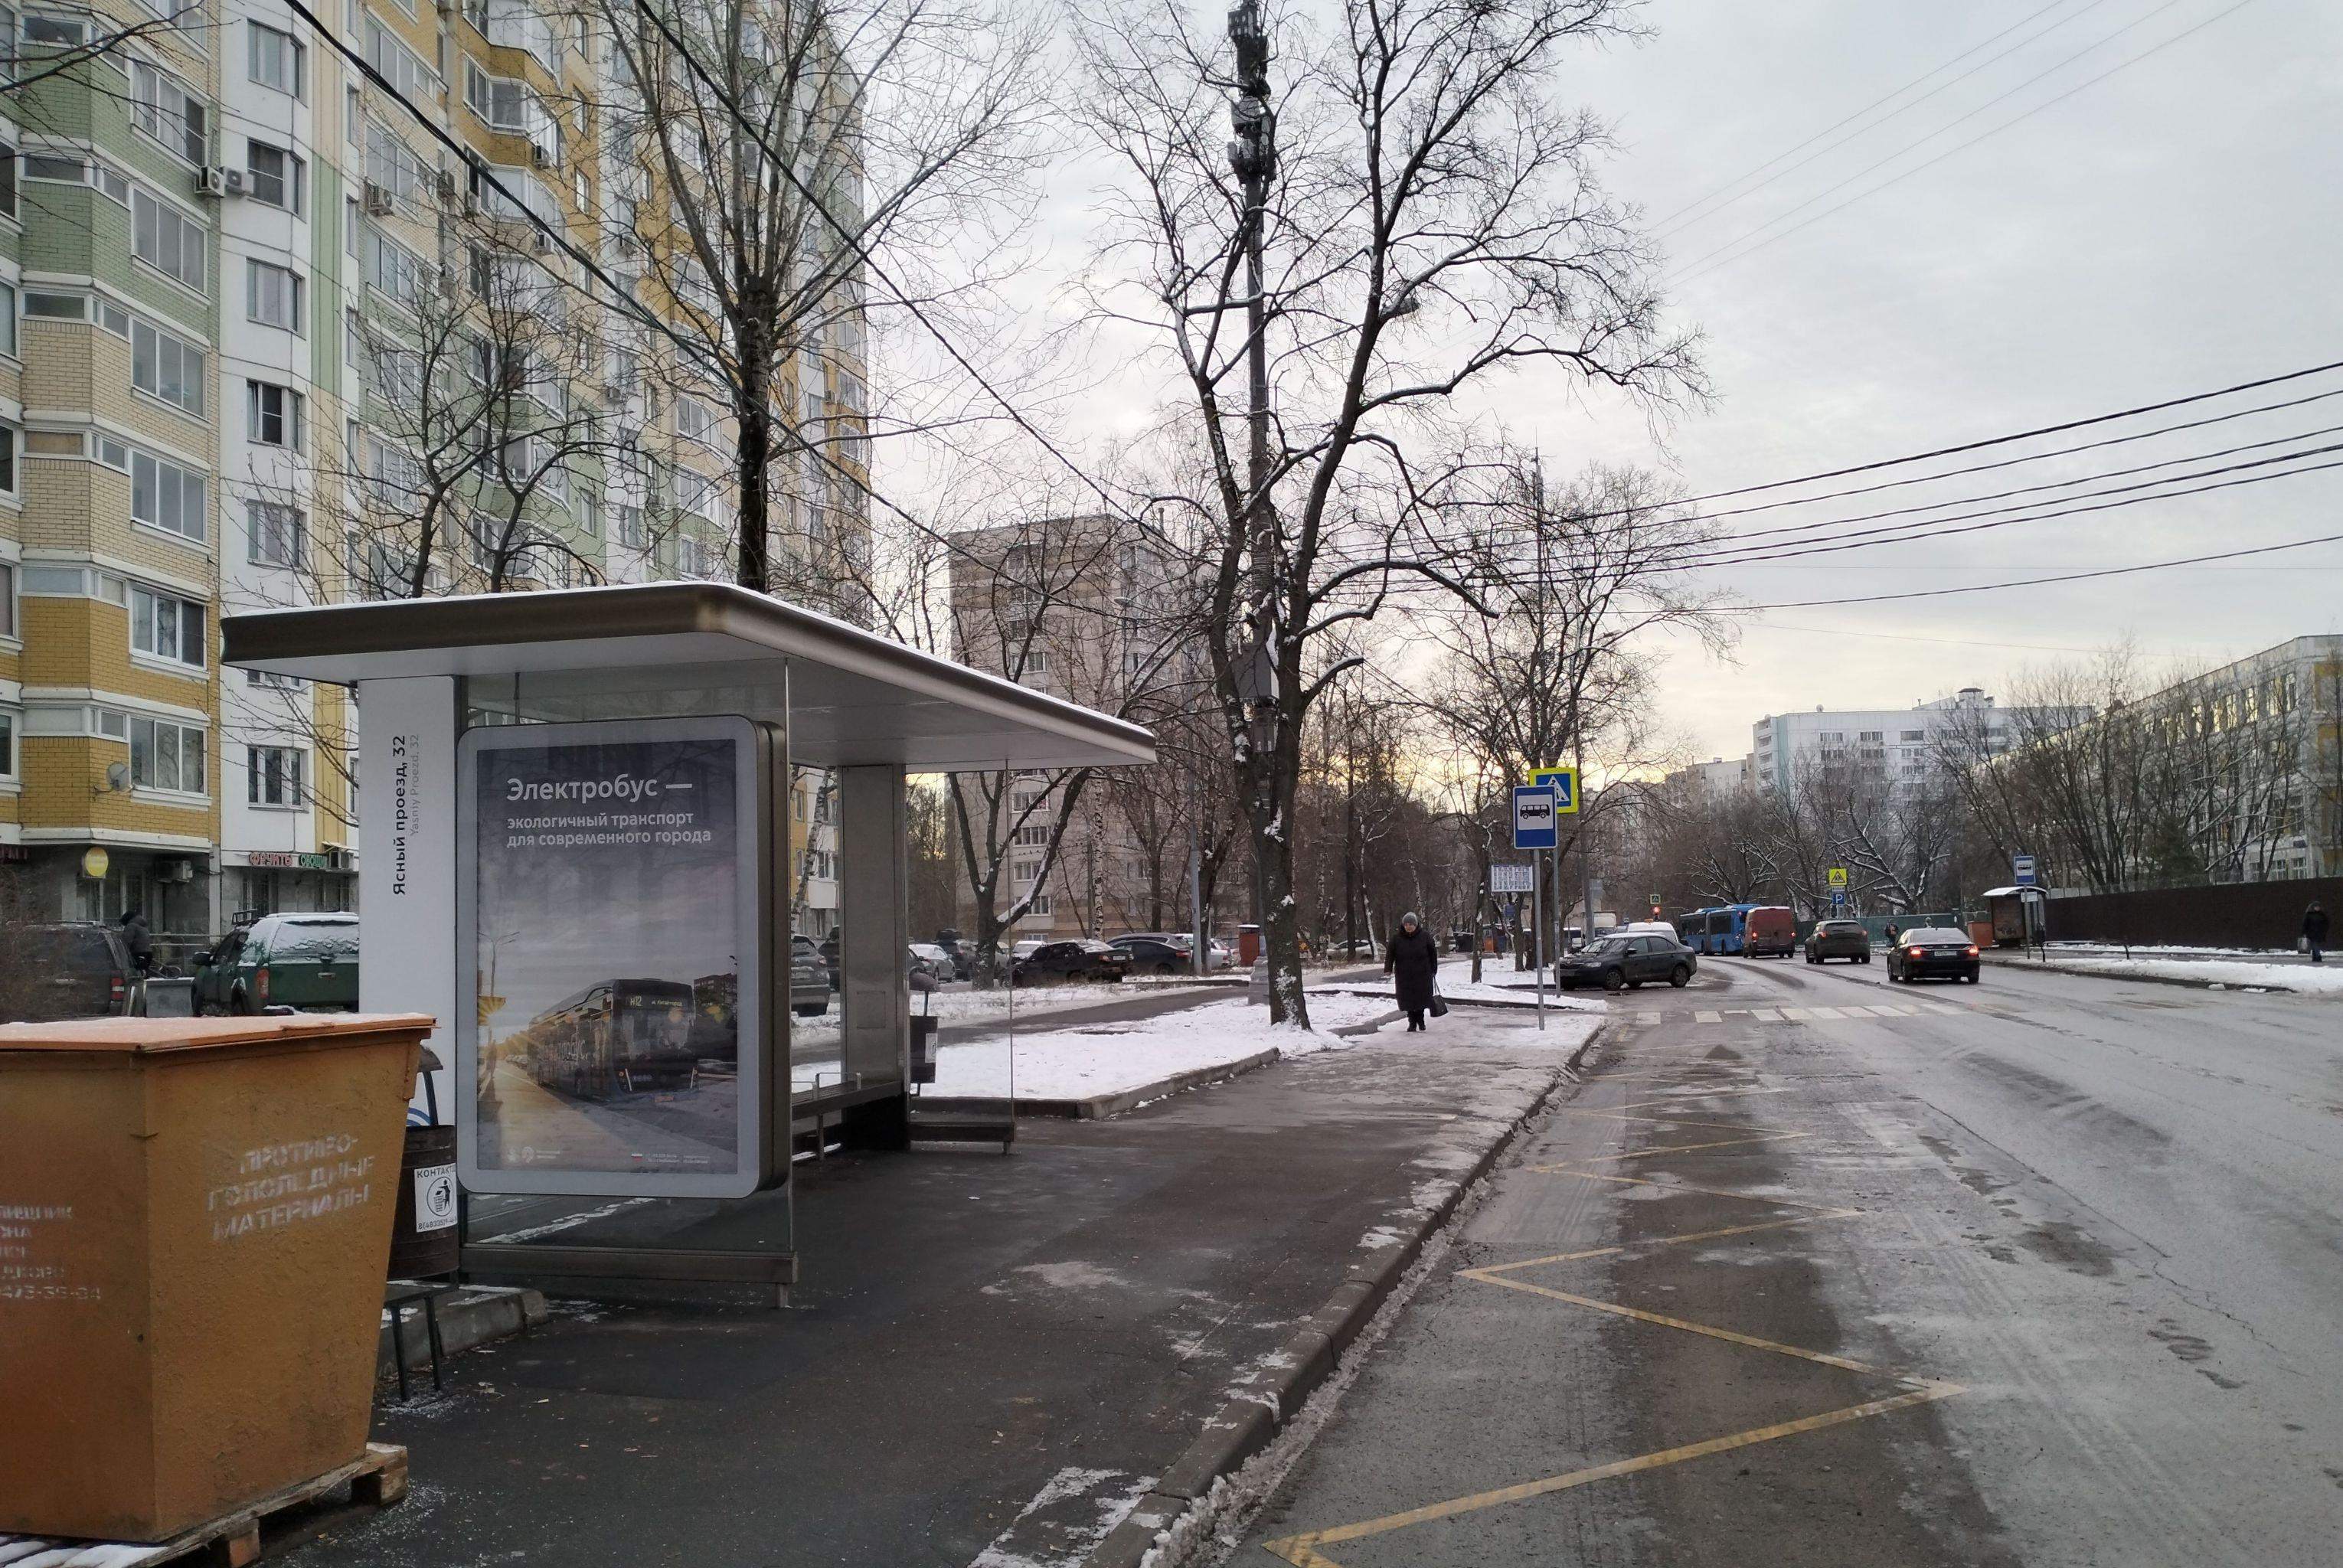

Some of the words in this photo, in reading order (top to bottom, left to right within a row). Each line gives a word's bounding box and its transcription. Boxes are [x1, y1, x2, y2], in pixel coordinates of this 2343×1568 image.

[393, 735, 405, 756] 32
[410, 735, 419, 748] 32
[410, 752, 420, 795] Proezd,
[395, 763, 408, 831] проезд,
[506, 773, 658, 803] Электробус
[410, 799, 421, 835] Yasniy
[507, 812, 607, 830] экологичный
[611, 812, 693, 828] транспорт
[507, 832, 534, 848] для
[539, 831, 651, 847] современного
[655, 830, 711, 844] города
[249, 851, 292, 867] ФРУКТЫ
[393, 837, 406, 895] Ясный
